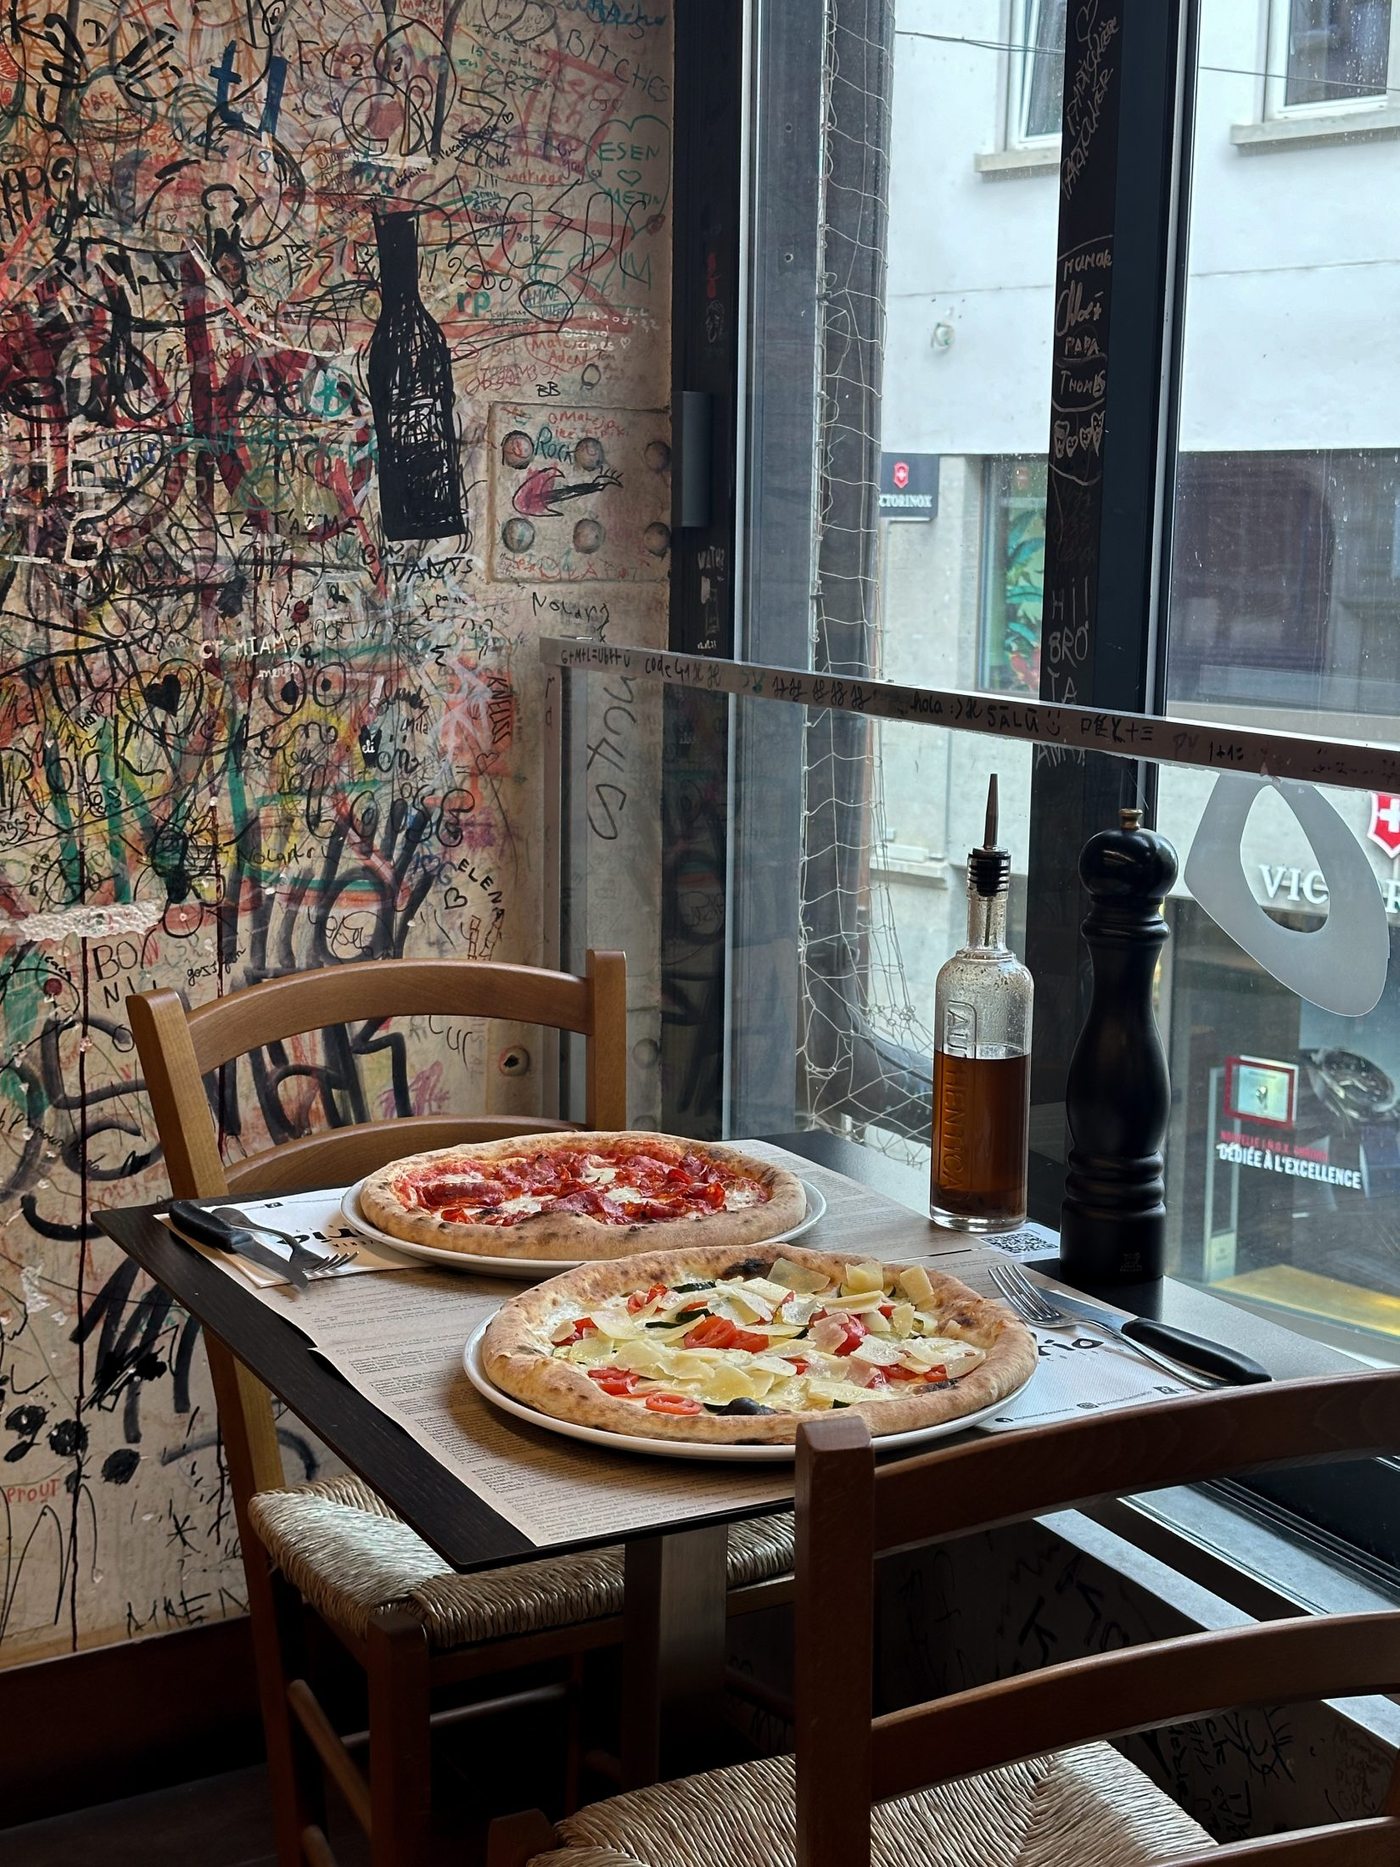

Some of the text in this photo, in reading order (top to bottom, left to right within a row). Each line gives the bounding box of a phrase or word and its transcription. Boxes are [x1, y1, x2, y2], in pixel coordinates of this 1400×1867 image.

[598, 142, 659, 161] ESEN
[457, 857, 506, 922] ELENA
[1216, 1142, 1263, 1169] DÉDIÉE
[1263, 1149, 1274, 1171] À
[1274, 1154, 1362, 1190] L'EXCELLENCE
